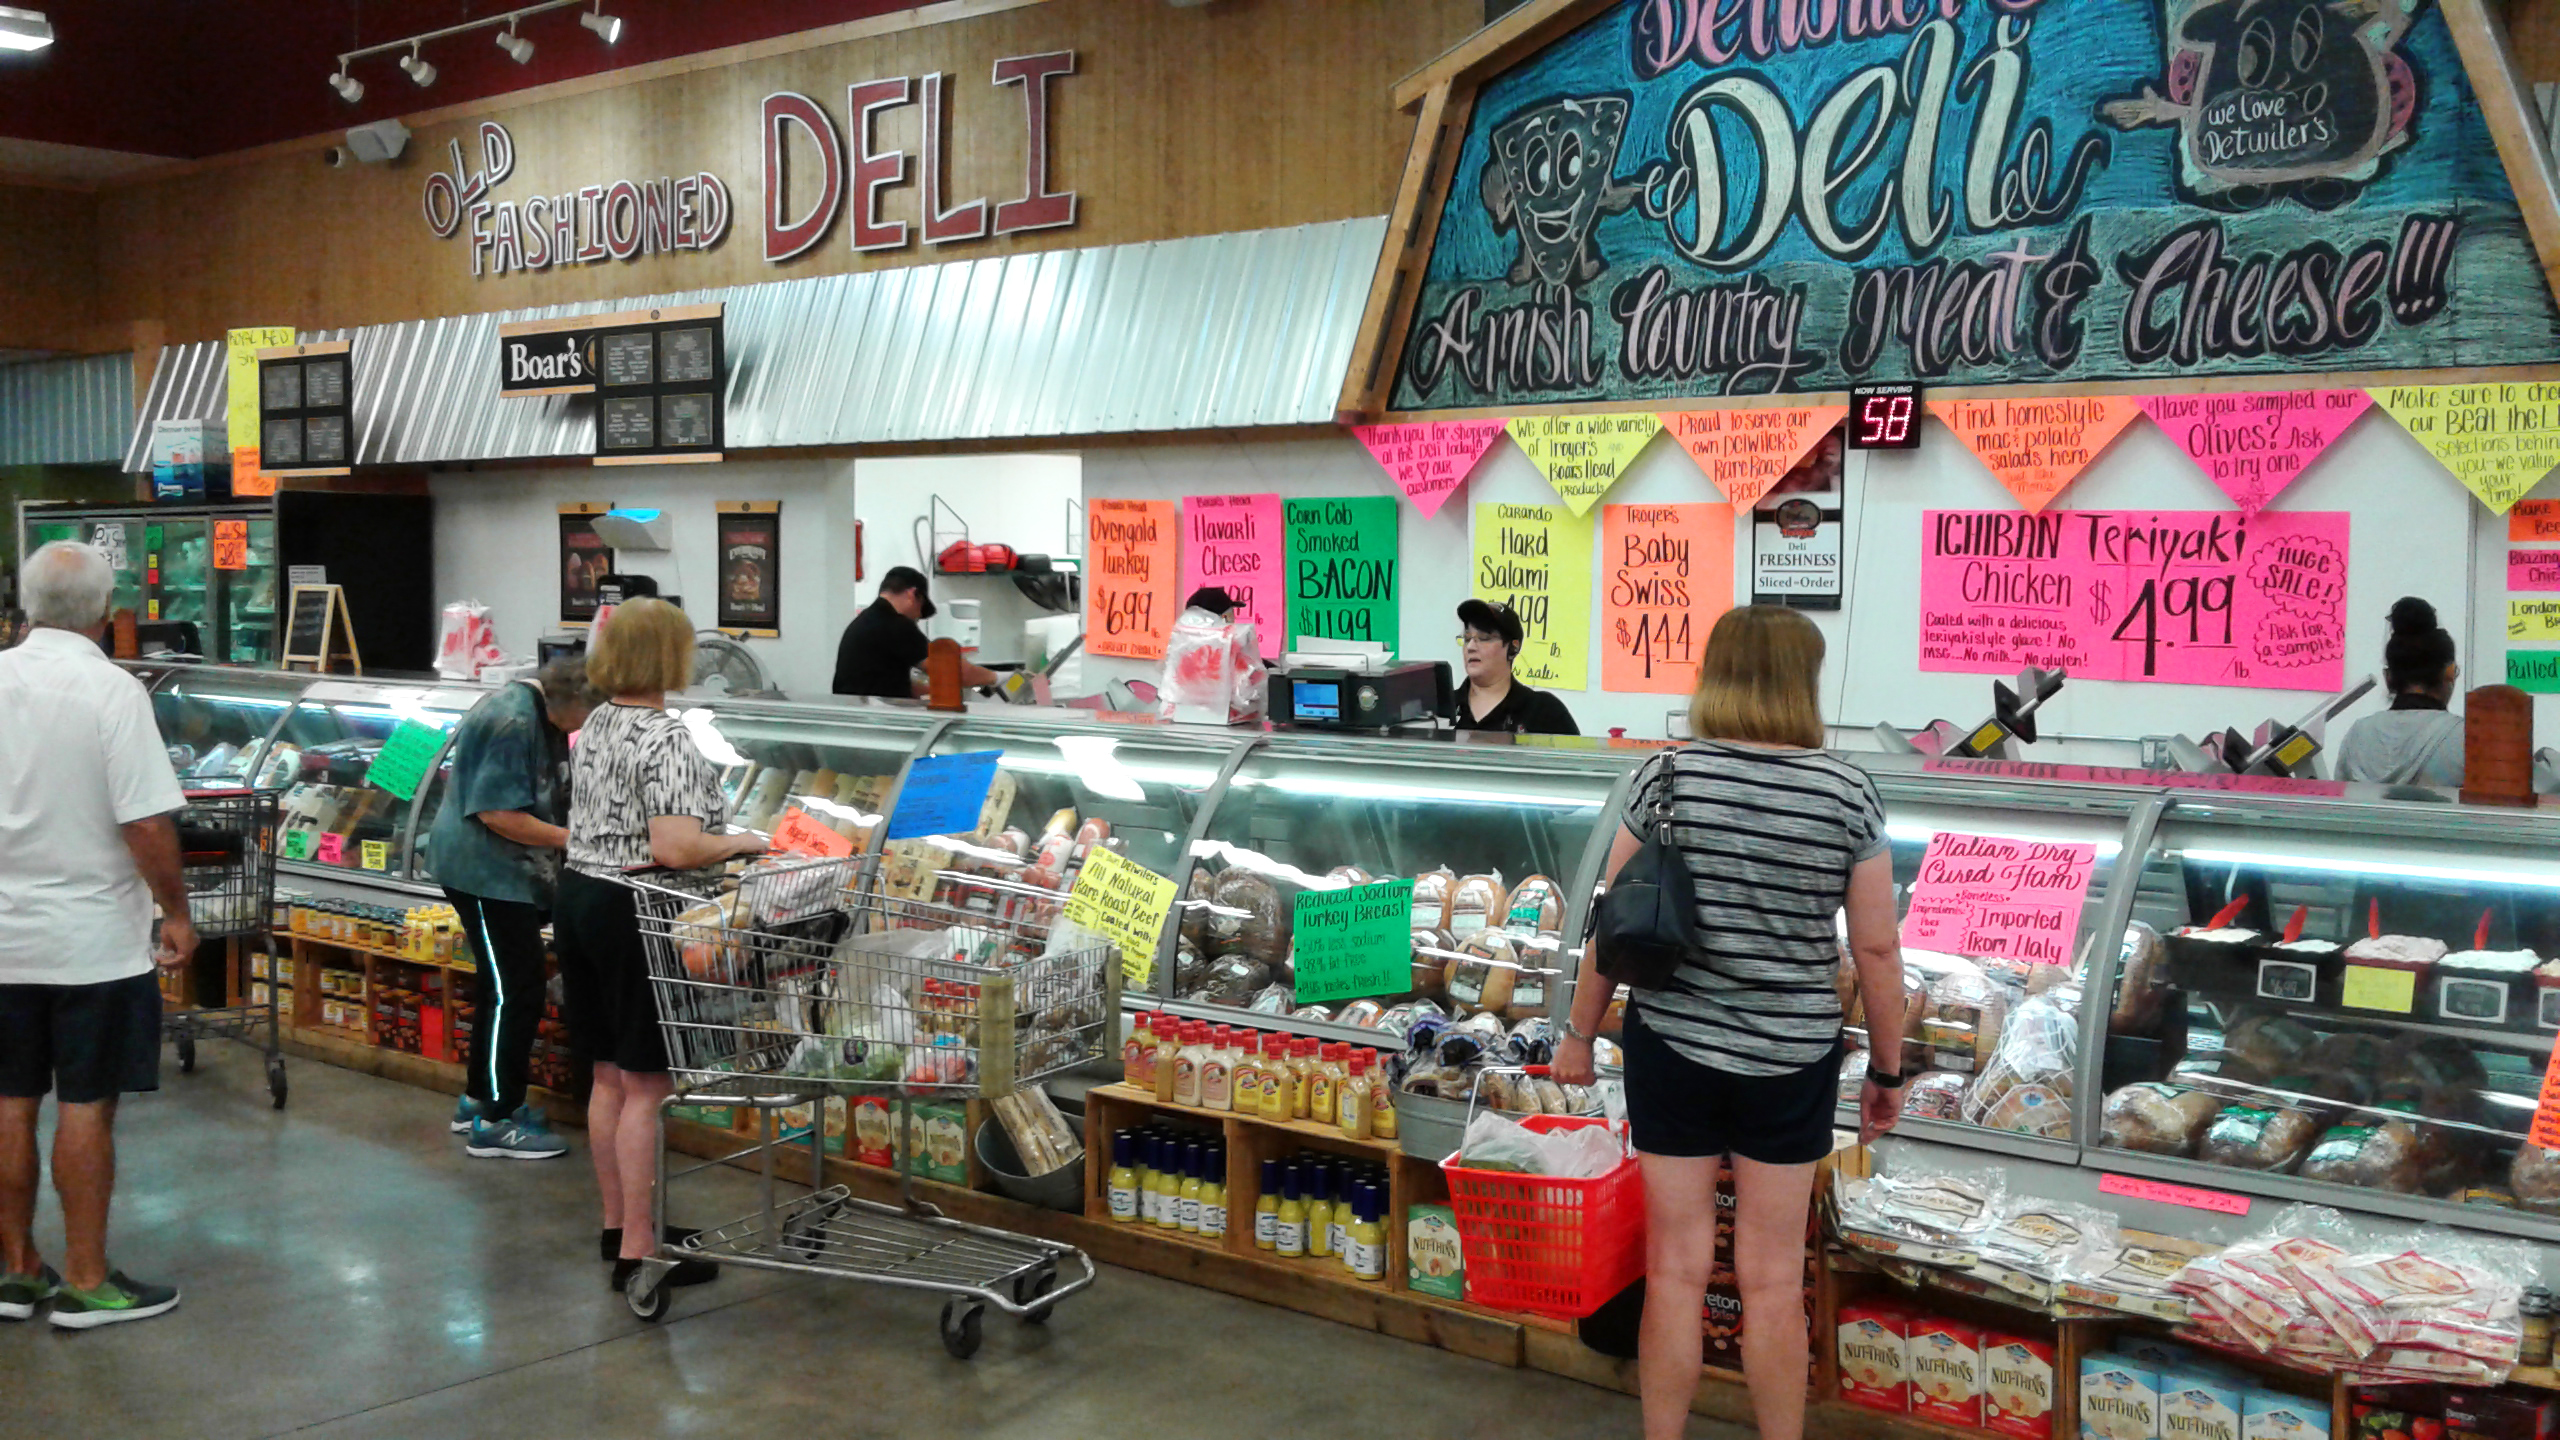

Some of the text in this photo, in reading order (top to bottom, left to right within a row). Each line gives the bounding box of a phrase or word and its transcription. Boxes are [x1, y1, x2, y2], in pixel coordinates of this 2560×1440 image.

[1650, 15, 2090, 266] Deli
[761, 49, 1077, 262] DELI
[423, 122, 514, 238] OLD
[471, 171, 730, 275] FASHIONED
[1412, 286, 1600, 390] Amish
[1621, 268, 1820, 397] Country
[2041, 226, 2095, 363] &
[510, 337, 582, 381] Boar's
[1876, 385, 1914, 394] SERVING
[2390, 384, 2516, 409] Make sure to
[1861, 396, 1914, 442] 58
[1949, 399, 2105, 432] Find homestyle
[2151, 391, 2359, 424] Have you sampled our
[1367, 425, 1401, 446] Thank
[1404, 428, 1425, 447] you
[1431, 422, 1449, 441] for
[1542, 418, 1569, 436] offer
[1576, 421, 1584, 434] a
[1588, 416, 1613, 434] wide
[1616, 416, 1657, 438] variety
[1679, 410, 1811, 436] Proud to serve our
[2410, 415, 2438, 433] our
[2446, 408, 2496, 435] Beat
[1528, 439, 1540, 457] of
[1692, 440, 1719, 456] own
[1976, 428, 2081, 454] mac potato
[2188, 415, 2325, 458] Olives? Ask
[2435, 436, 2510, 459] selections
[1585, 457, 1616, 480] Head
[1714, 455, 1787, 483] Rare Roast
[1989, 448, 2090, 471] salads here
[2213, 454, 2300, 483] to try one
[2519, 453, 2555, 470] value
[1406, 477, 1457, 497] customers
[1729, 480, 1765, 504] Beef
[2480, 472, 2516, 494] your
[1288, 502, 1352, 527] Corn Cob
[1498, 504, 1552, 522] Carando
[1627, 505, 1680, 528] Troyer's
[1091, 514, 1157, 551] Ovengold
[1194, 512, 1256, 543] Havarti
[1297, 527, 1360, 554] Smoked
[1501, 526, 1548, 557] Hard
[1624, 532, 1690, 578] Baby
[1788, 541, 1807, 551] Deli
[1935, 513, 2247, 581] ICHIBAN Teriyaki
[1102, 546, 1150, 583] Turkey
[1202, 545, 1261, 577] Cheese
[1481, 556, 1549, 591] Salami
[1760, 553, 1836, 567] FRESHNESS
[2277, 547, 2331, 574] HUGE
[1298, 557, 1395, 602] BACON
[1611, 569, 1691, 608] Swiss
[1962, 561, 2073, 608] Chicken
[2264, 564, 2334, 605] SALE!
[1925, 612, 2067, 632] Coated with a delicious
[2269, 623, 2299, 640] Ask
[2058, 635, 2077, 650] No
[2263, 645, 2272, 656] a
[2507, 658, 2557, 679] Pulled
[1929, 832, 2095, 874] Italian Dry
[1088, 861, 1156, 906] All Natural
[1924, 858, 2082, 892] Cured Ham
[1073, 878, 1099, 901] Rare
[1100, 889, 1131, 916] Roast
[1130, 902, 1160, 928] Beef
[1296, 884, 1411, 911] Reduced Sodium
[1303, 900, 1405, 932] Turkey Breast
[1979, 906, 2062, 931] Imported
[1967, 931, 2063, 965] from Italy
[1704, 1292, 1742, 1312] reton
